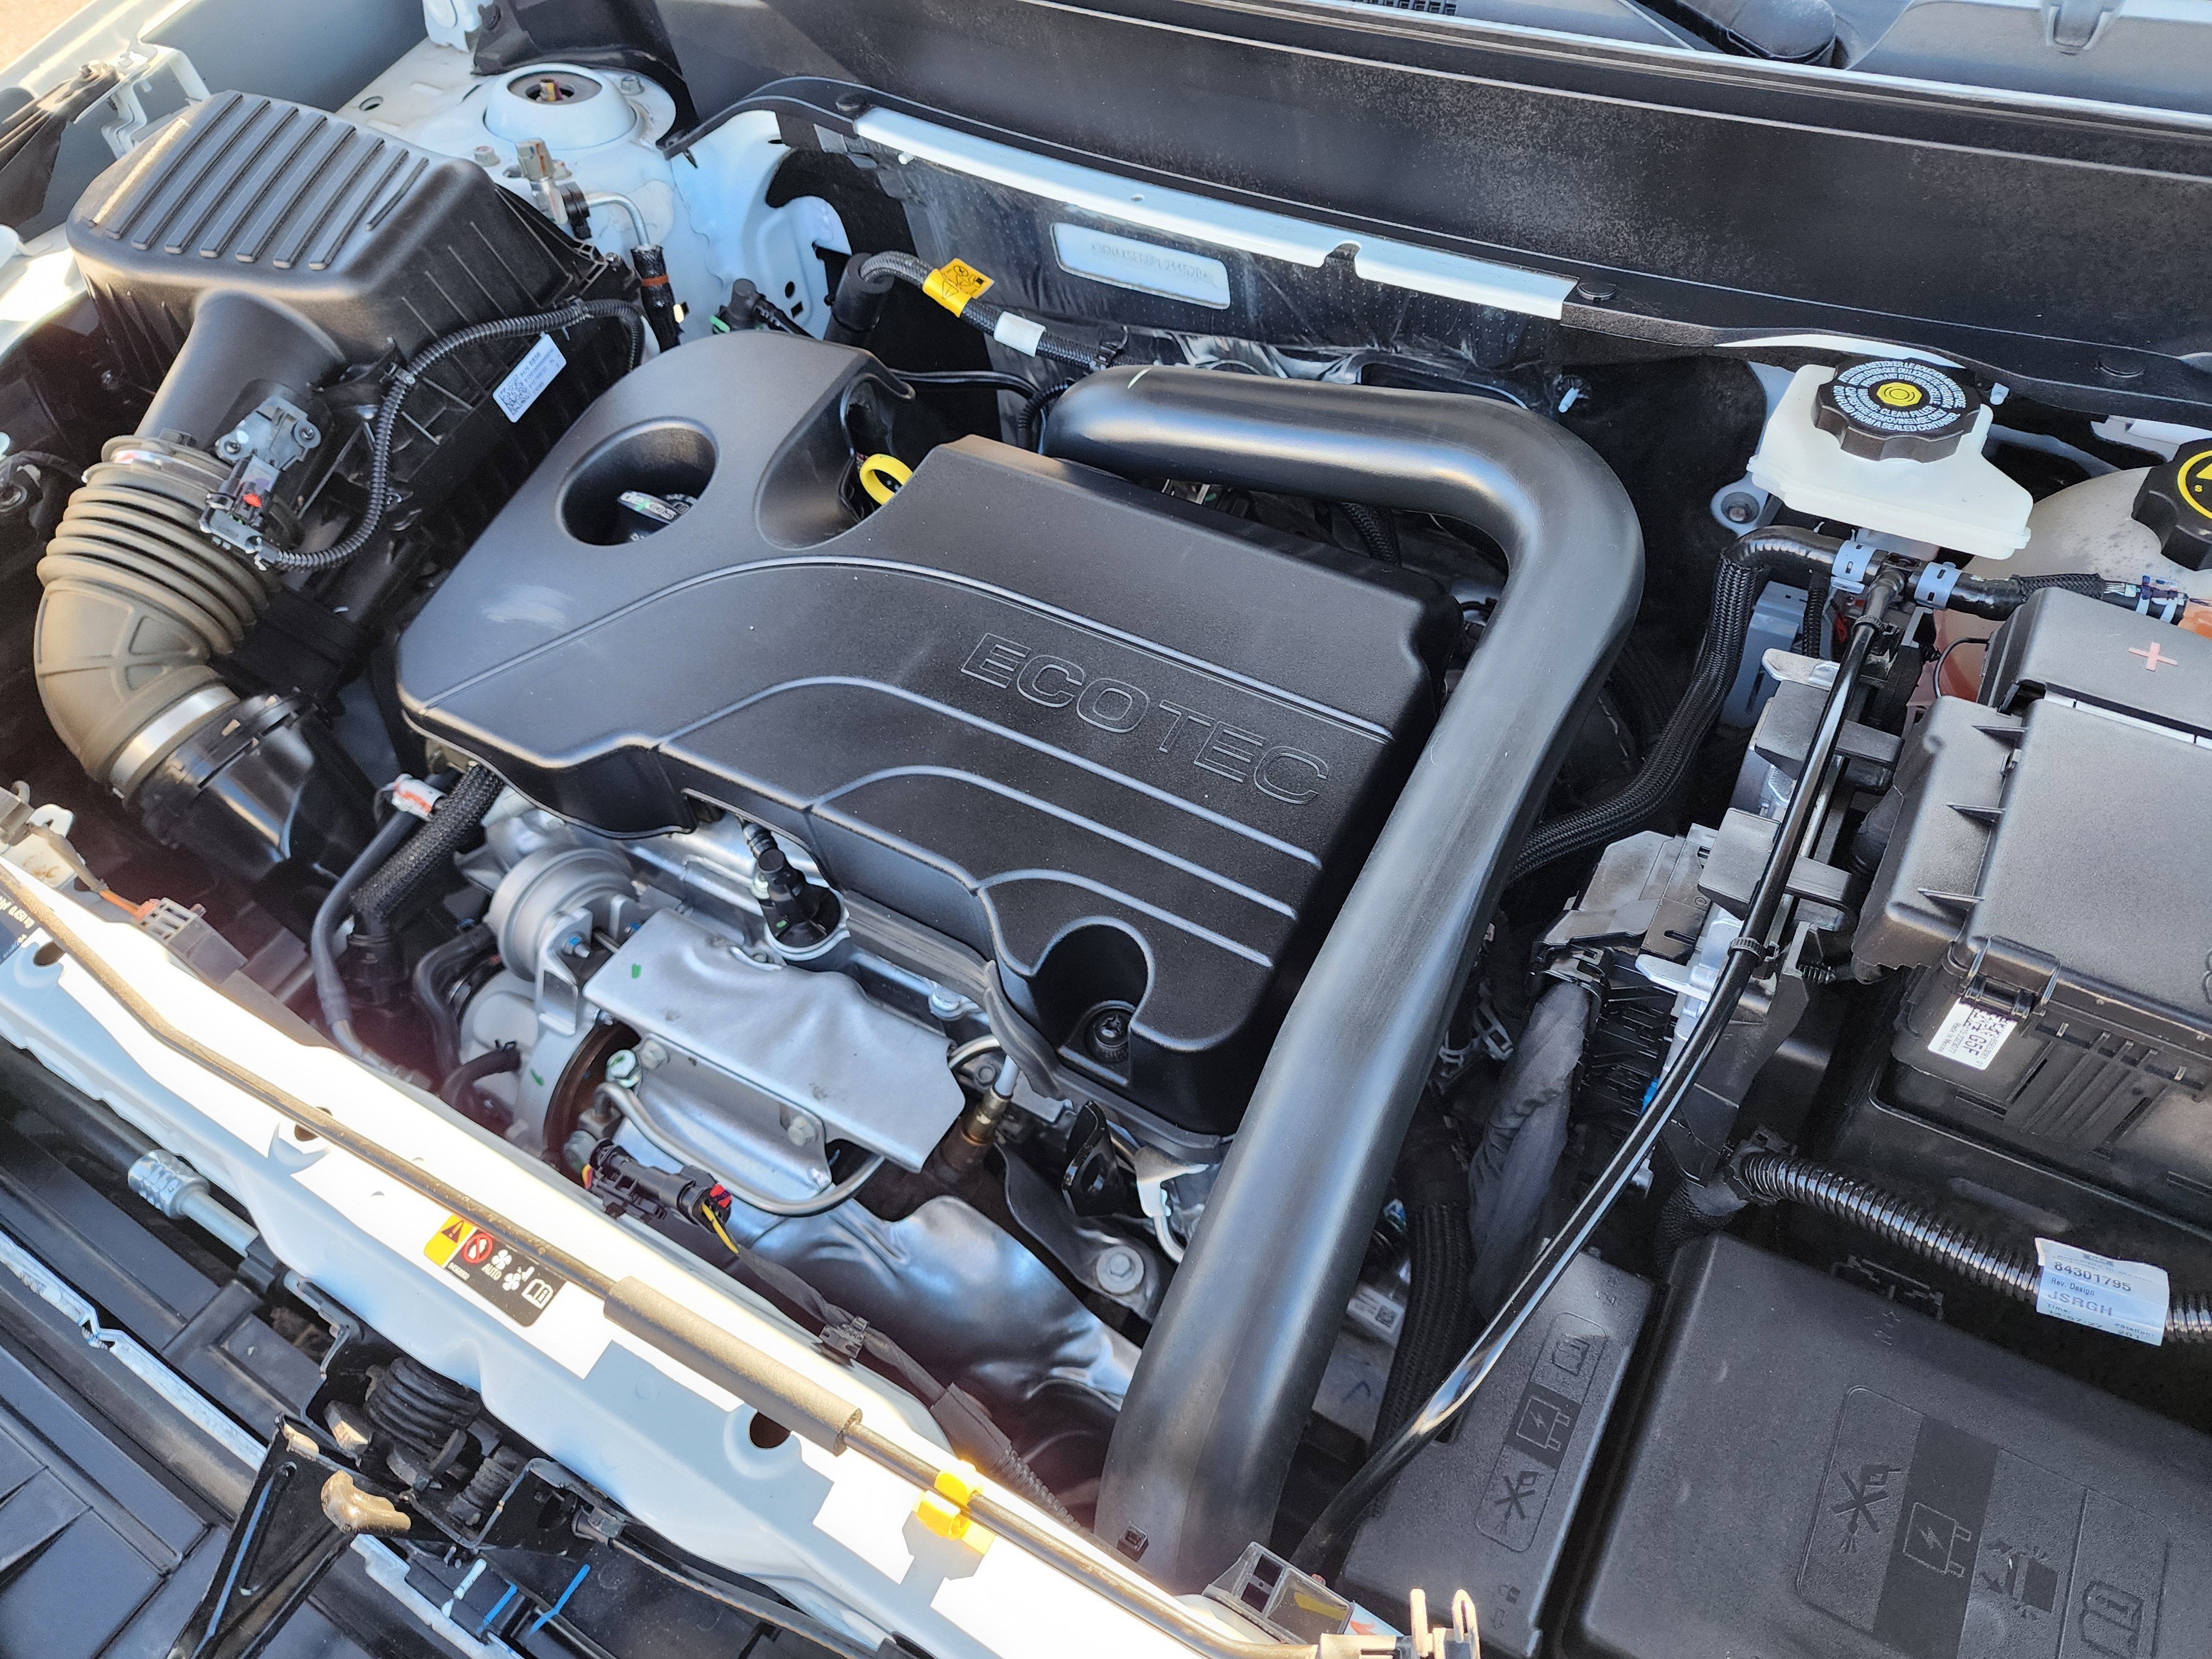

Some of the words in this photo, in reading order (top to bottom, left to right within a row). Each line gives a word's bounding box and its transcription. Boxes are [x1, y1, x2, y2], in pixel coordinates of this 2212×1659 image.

[1913, 364, 1947, 380] BOUCHON
[1856, 389, 1880, 411] WARNING:
[620, 490, 677, 520] dexos
[961, 632, 1329, 805] ECOTEC
[1961, 1032, 1987, 1056] G5F
[481, 1262, 502, 1281] AUTO
[2054, 1261, 2132, 1292] 84301795
[2051, 1277, 2067, 1288] Rev.
[2070, 1282, 2095, 1296] Design
[2047, 1290, 2113, 1316] JSRGH
